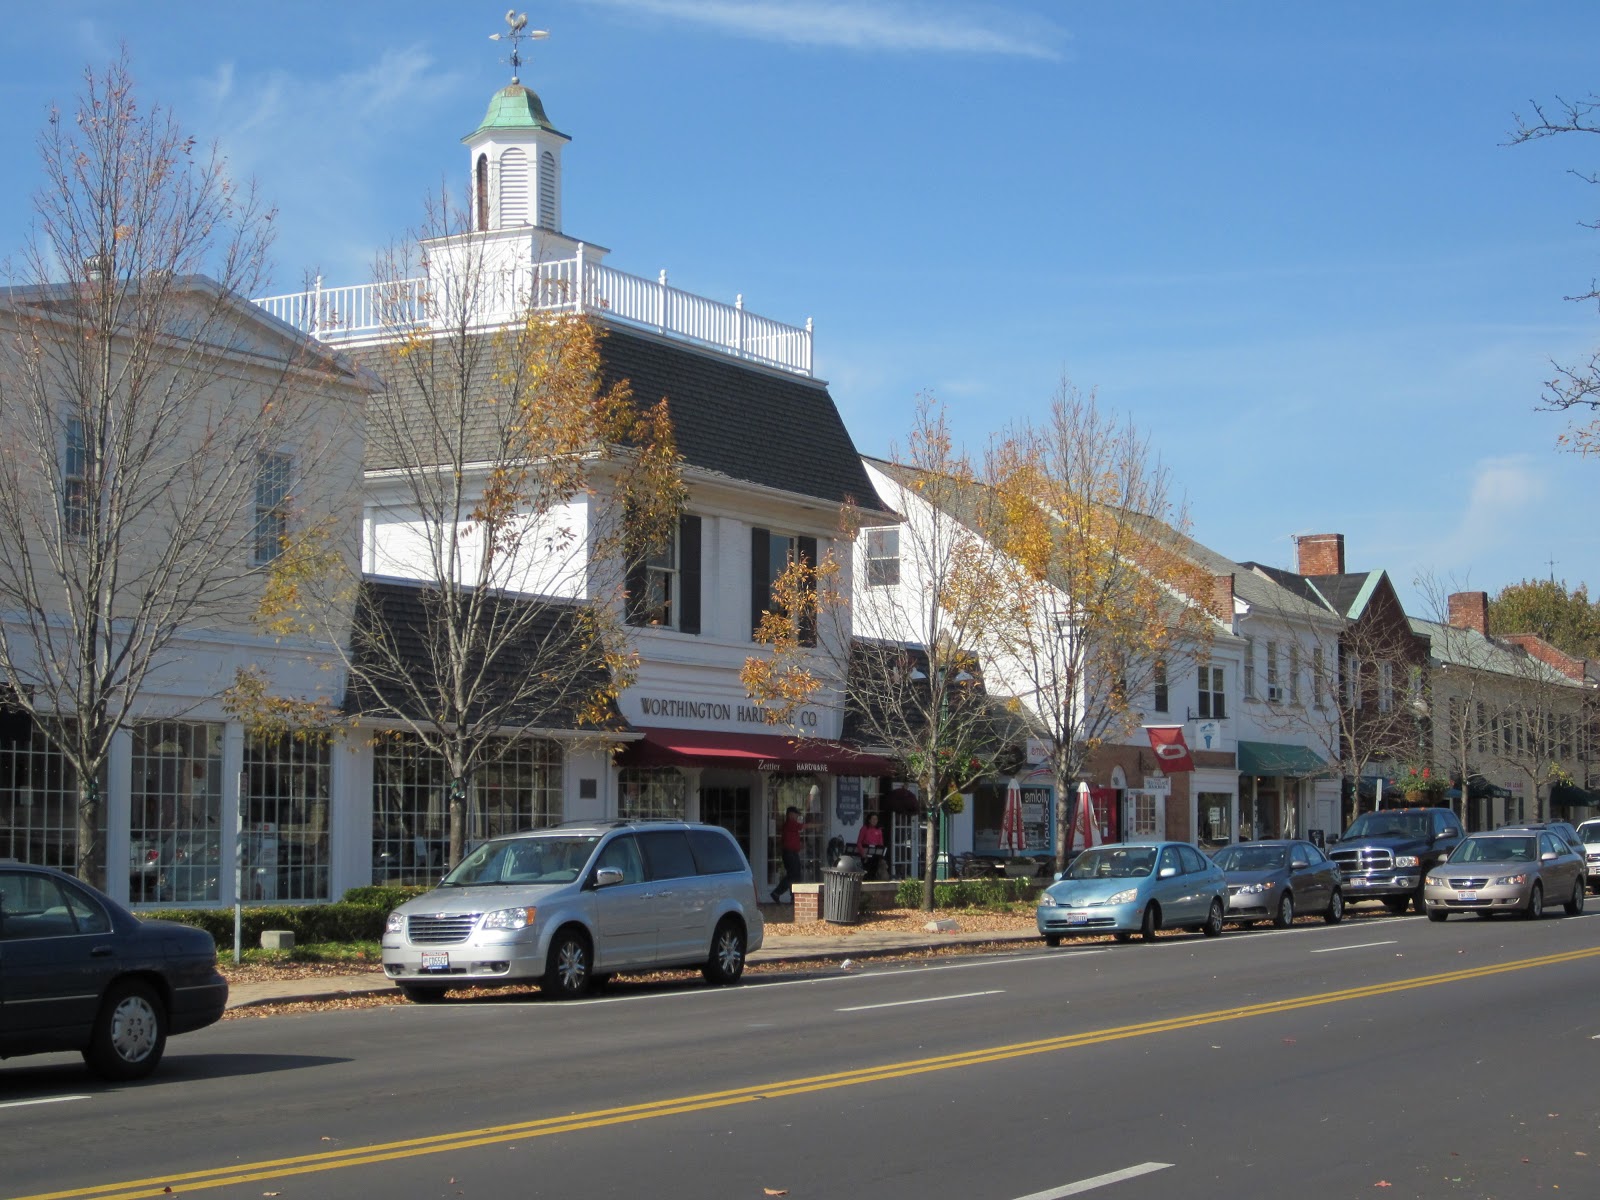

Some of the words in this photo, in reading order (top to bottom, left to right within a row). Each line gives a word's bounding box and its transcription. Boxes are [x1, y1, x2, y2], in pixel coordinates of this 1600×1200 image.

[641, 697, 731, 720] WORTHINGTON
[796, 763, 829, 772] HARDWARE
[1024, 789, 1050, 805] emlolly
